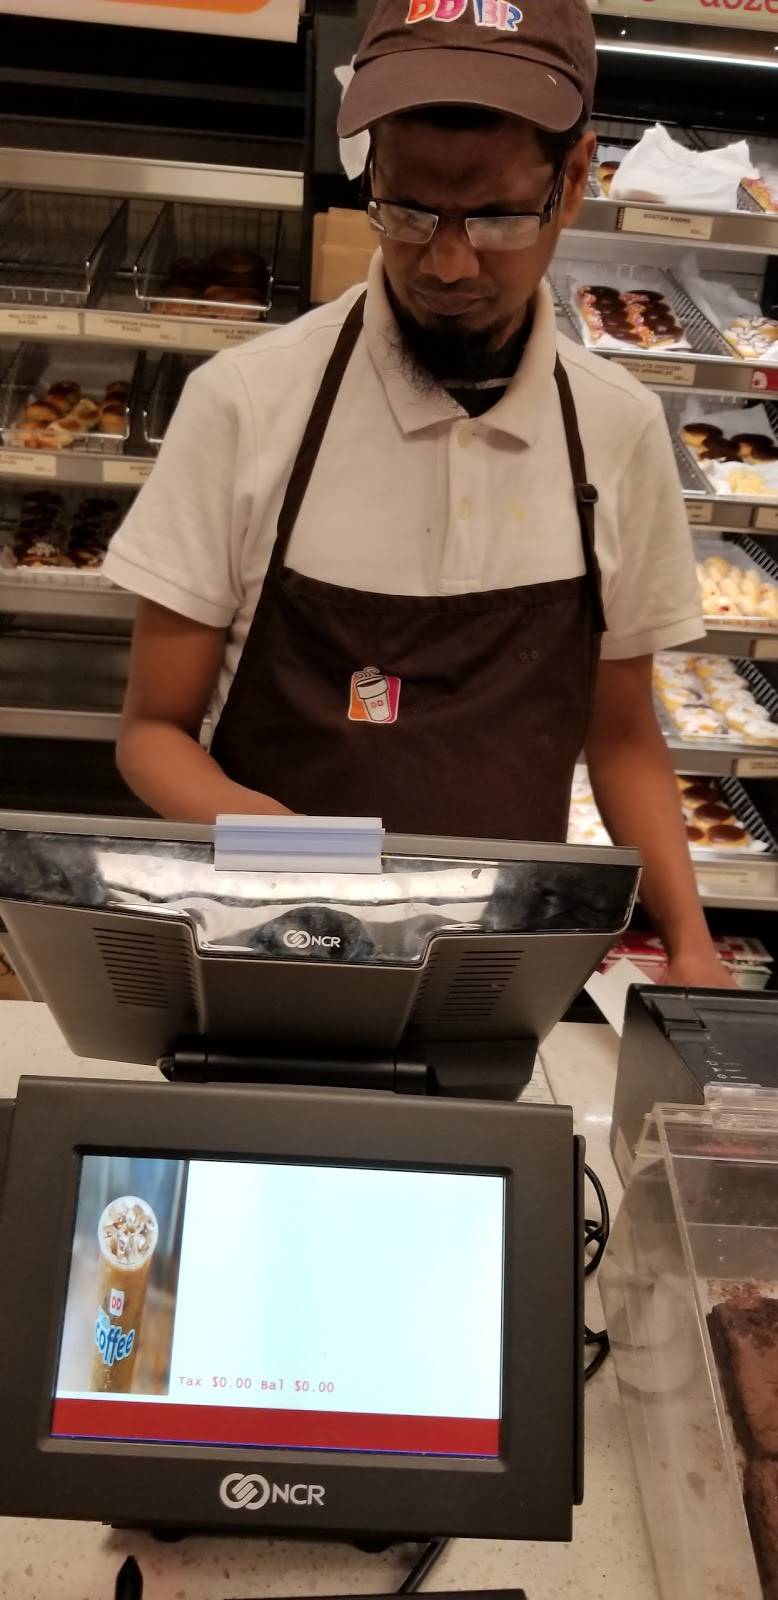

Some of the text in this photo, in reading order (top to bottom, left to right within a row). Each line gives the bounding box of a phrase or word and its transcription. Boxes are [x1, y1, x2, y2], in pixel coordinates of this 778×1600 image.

[405, 0, 468, 24] DD
[311, 935, 341, 948] NCR
[179, 1376, 335, 1393] Tax $0.00 Bal $0.00
[271, 1482, 326, 1506] NCR
